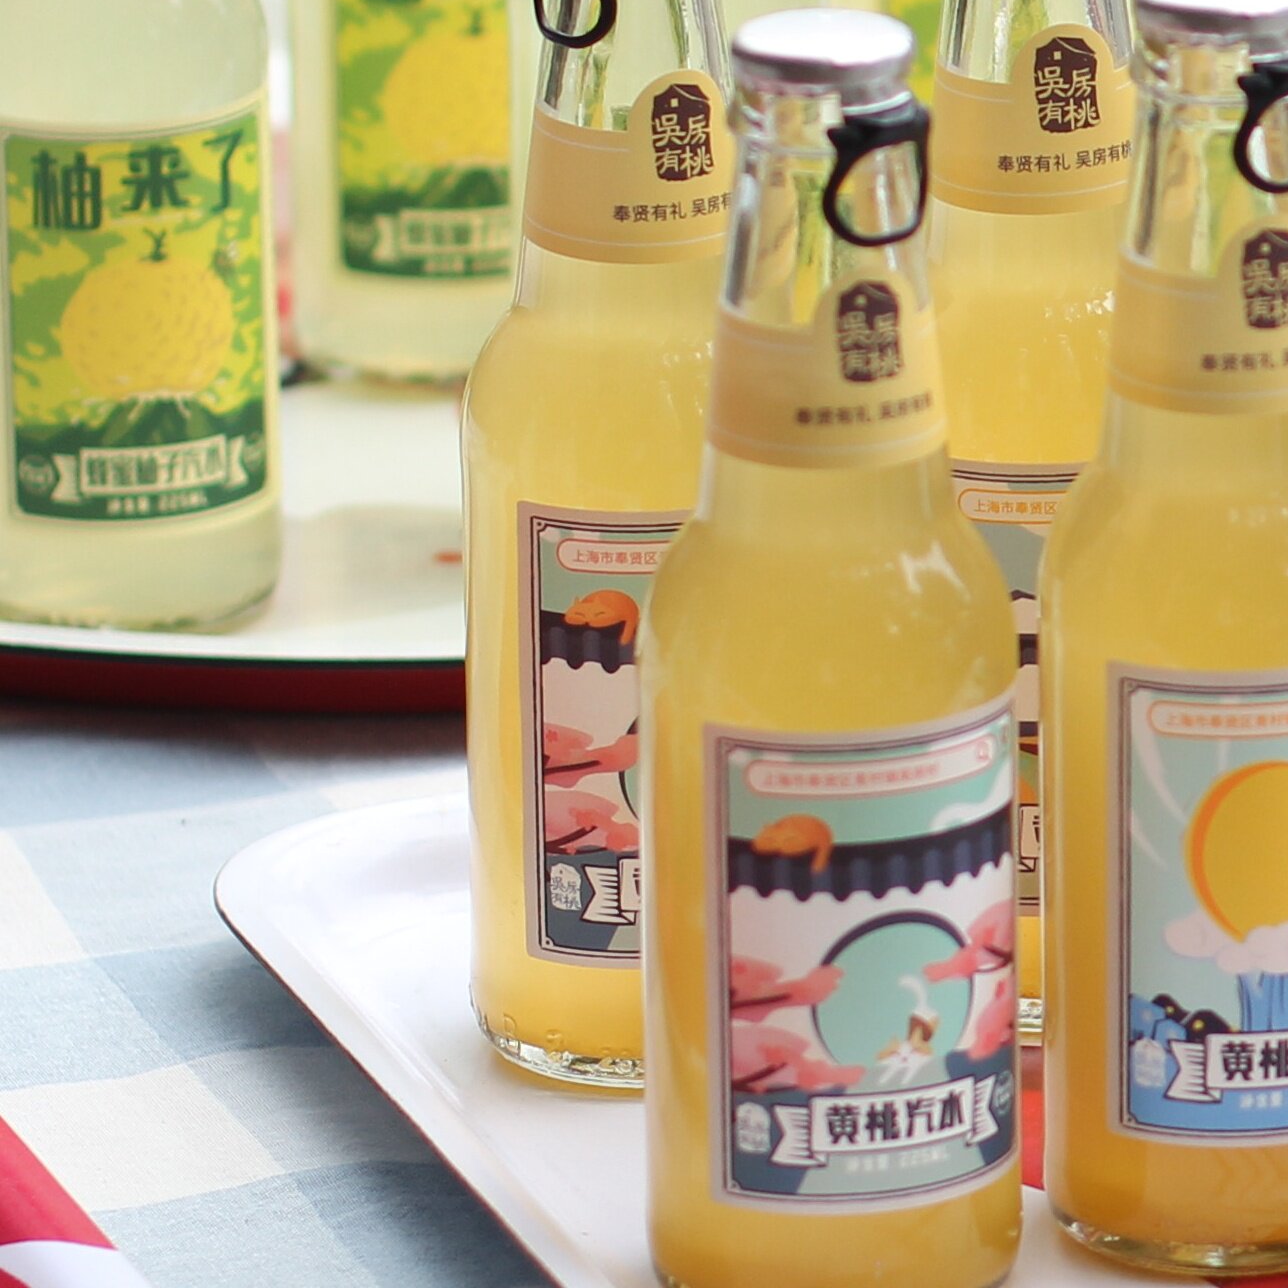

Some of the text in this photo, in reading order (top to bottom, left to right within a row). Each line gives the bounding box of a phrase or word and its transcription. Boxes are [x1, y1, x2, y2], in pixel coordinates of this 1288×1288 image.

[997, 140, 1132, 173] 奉贤有礼 吴房有桃
[31, 129, 243, 230] 柚来了
[613, 192, 732, 223] 奉贤有礼 吴房有
[573, 549, 662, 566] 上海市奉贤区
[826, 1091, 966, 1144] 黄桃汽水
